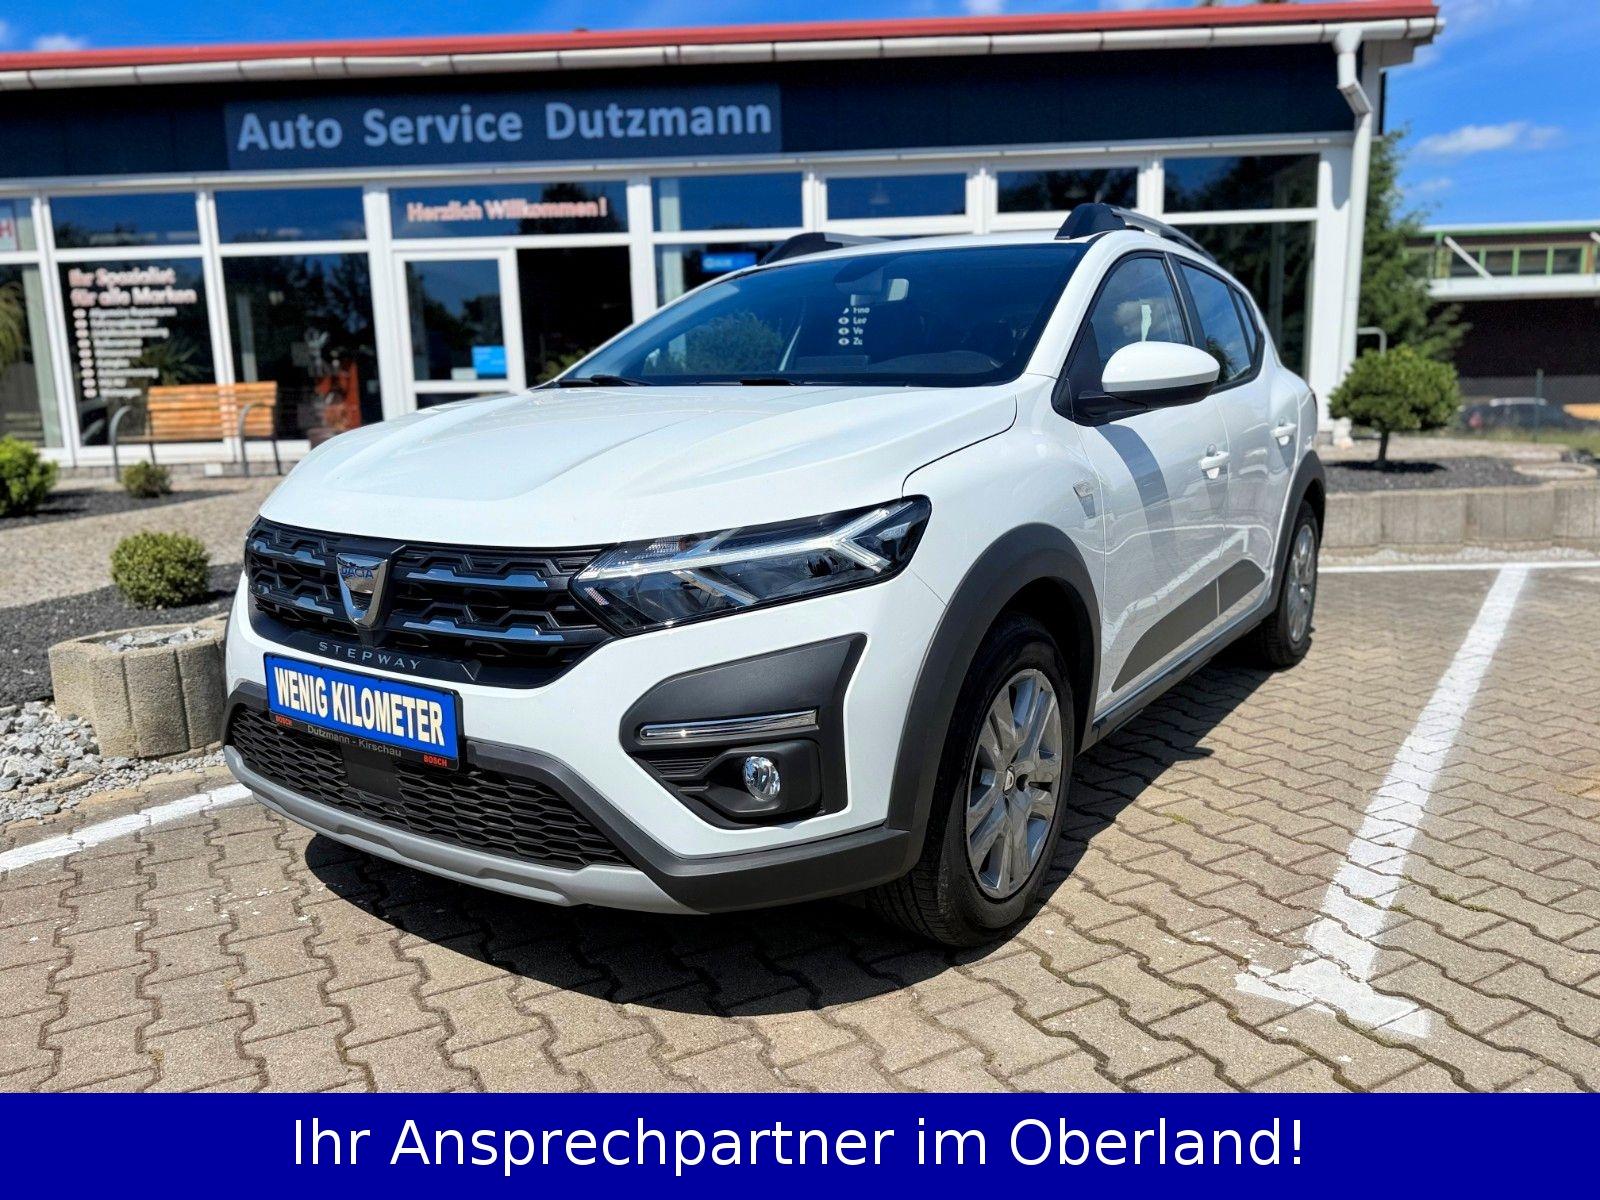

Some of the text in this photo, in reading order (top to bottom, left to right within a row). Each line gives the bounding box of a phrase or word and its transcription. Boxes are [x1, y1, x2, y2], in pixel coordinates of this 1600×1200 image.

[237, 99, 772, 151] Auto Service Dutzmann
[407, 199, 483, 223] Herzlich
[341, 566, 374, 580] DACIA
[317, 641, 422, 671] STEPWAY
[274, 666, 446, 747] WENIG KILOMETER
[274, 714, 293, 728] BOSCH
[307, 724, 350, 746] Dutzmann
[358, 738, 402, 757] Kirschau
[423, 754, 448, 768] BOSCH
